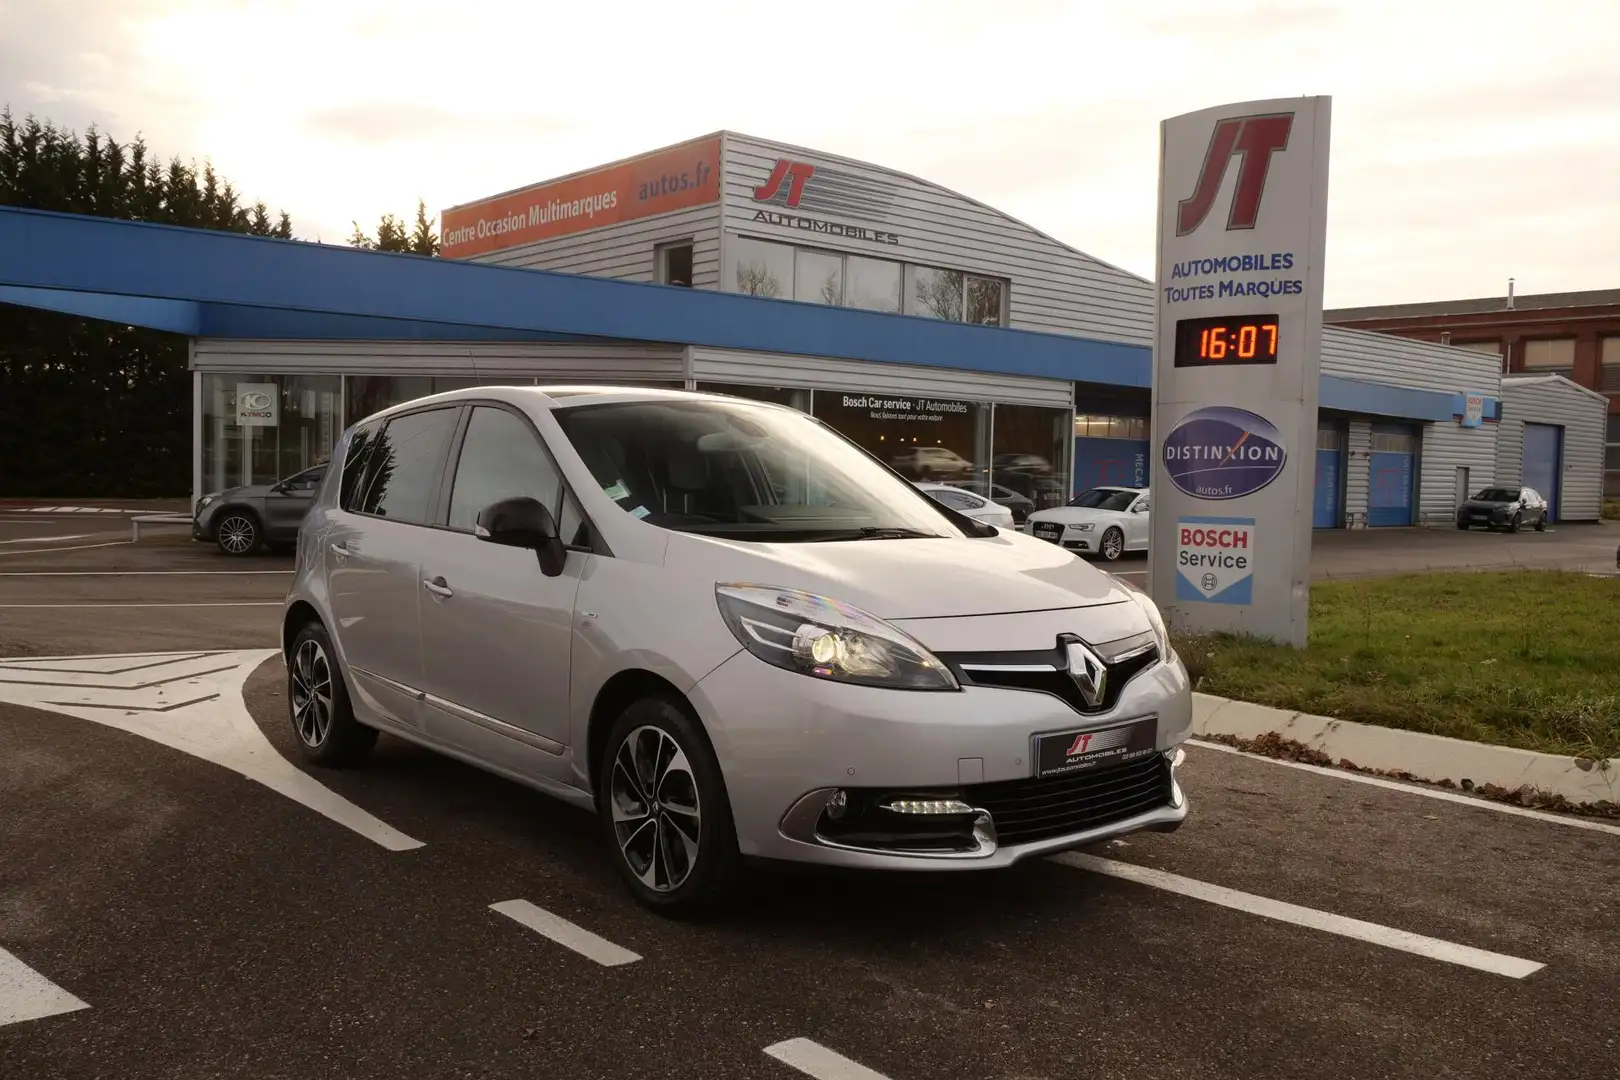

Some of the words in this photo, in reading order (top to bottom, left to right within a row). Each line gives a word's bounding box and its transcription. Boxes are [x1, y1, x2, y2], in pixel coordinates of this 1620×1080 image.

[638, 162, 711, 201] autos.fr
[753, 158, 815, 209] JT
[1176, 112, 1295, 237] JT
[442, 222, 475, 247] Centre
[477, 213, 526, 239] Occasion
[529, 190, 617, 226] Multimarques
[752, 210, 899, 245] AUTOMOBILES
[1171, 252, 1294, 279] AUTOMOBILES
[1164, 285, 1214, 304] TOUTES
[1218, 280, 1303, 298] MARQUES
[1200, 324, 1277, 359] 16:07
[843, 396, 867, 407] Bosch
[868, 397, 882, 409] Car
[883, 399, 911, 410] service
[916, 400, 925, 411] JT
[926, 401, 968, 413] Automobiles
[1166, 445, 1278, 461] DISTINXION
[1195, 484, 1233, 495] autos.fr
[1180, 528, 1248, 548] BOSCH
[1179, 550, 1247, 569] Service
[1066, 734, 1093, 756] JT
[1066, 747, 1127, 763] AUTOMOBILES
